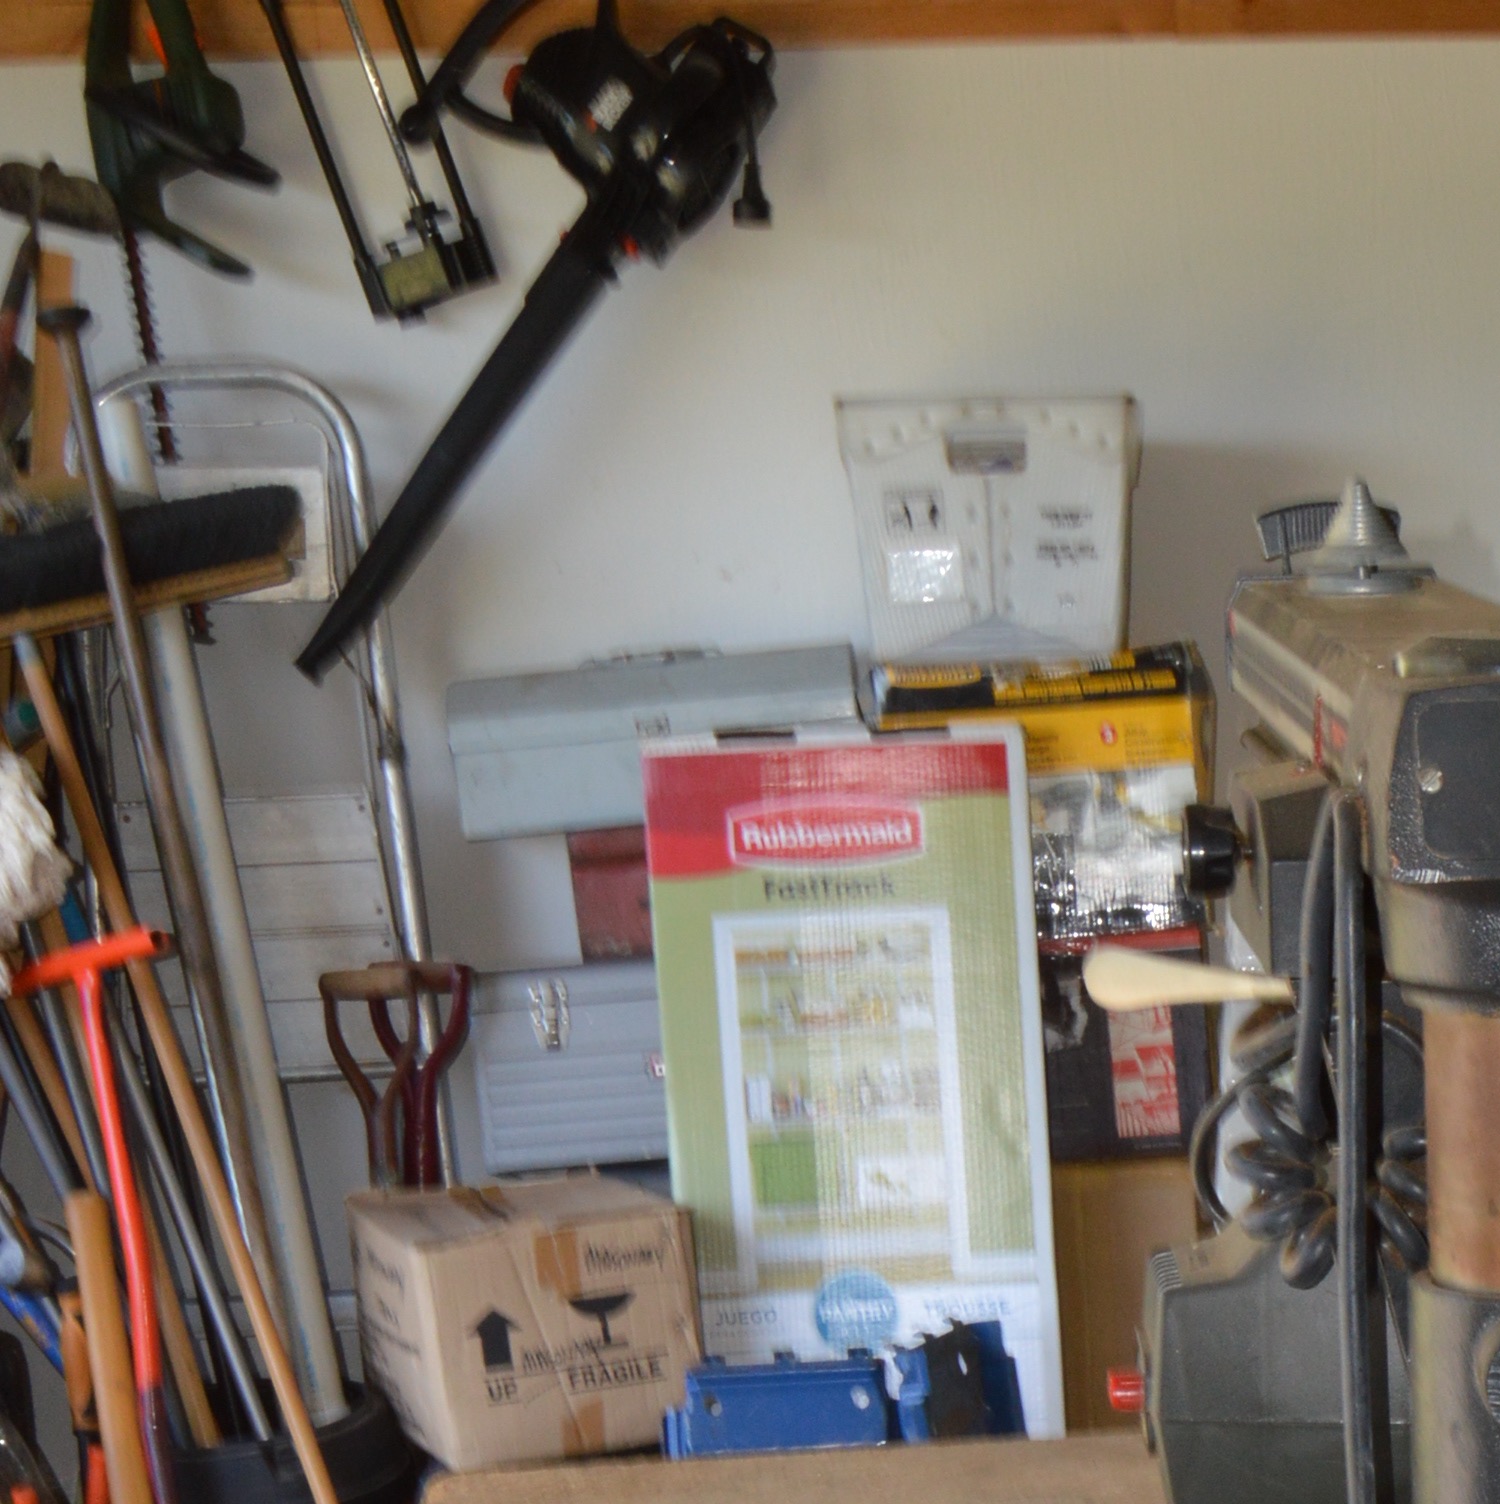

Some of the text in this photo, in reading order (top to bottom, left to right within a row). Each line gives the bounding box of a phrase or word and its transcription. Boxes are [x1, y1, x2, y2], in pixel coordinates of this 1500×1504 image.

[741, 821, 912, 851] Rubbermaid
[715, 1308, 778, 1326] JUEGO
[485, 1356, 663, 1402] UP FRAGILE
